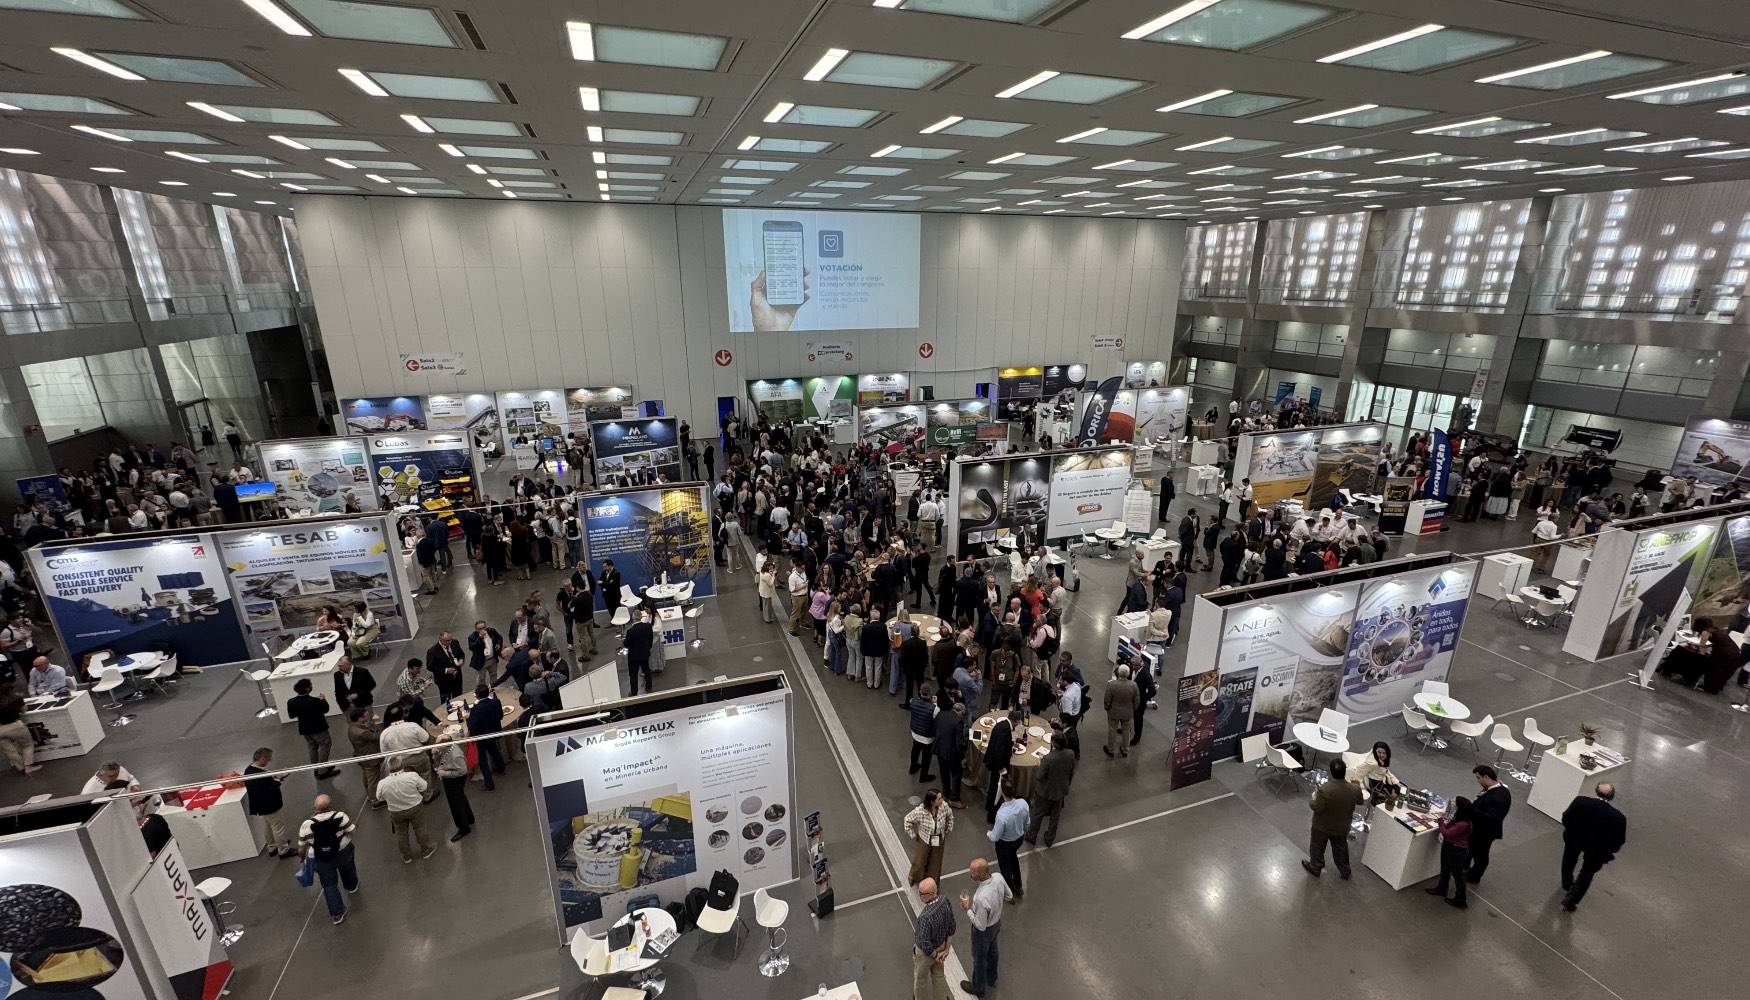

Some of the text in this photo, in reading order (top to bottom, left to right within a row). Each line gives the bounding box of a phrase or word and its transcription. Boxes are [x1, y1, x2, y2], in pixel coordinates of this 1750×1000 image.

[819, 263, 863, 272] VOTACIÓN
[1087, 398, 1108, 438] ORICA
[266, 530, 340, 547] TESAB
[1649, 530, 1698, 548] ANEFHOP
[296, 556, 332, 564] TRITURACIÓN
[337, 552, 367, 560] RECICLAJE
[52, 566, 144, 582] CONSISTENT QUALITY
[55, 574, 134, 590] RELIABLE SERVICE
[59, 583, 122, 597] FAST DELIVERY
[1432, 609, 1452, 619] Áridos
[1227, 616, 1283, 635] ANEFA
[1427, 622, 1459, 635] para todos
[1271, 670, 1296, 684] SCIMIN
[586, 720, 676, 746] MAOTTEAUX
[632, 734, 657, 745] Koppers
[657, 731, 676, 739] Group
[701, 742, 772, 761] múltiples aplicaciones
[715, 742, 745, 751] máquina,
[615, 769, 642, 781] Minería
[643, 764, 668, 774] Urbana
